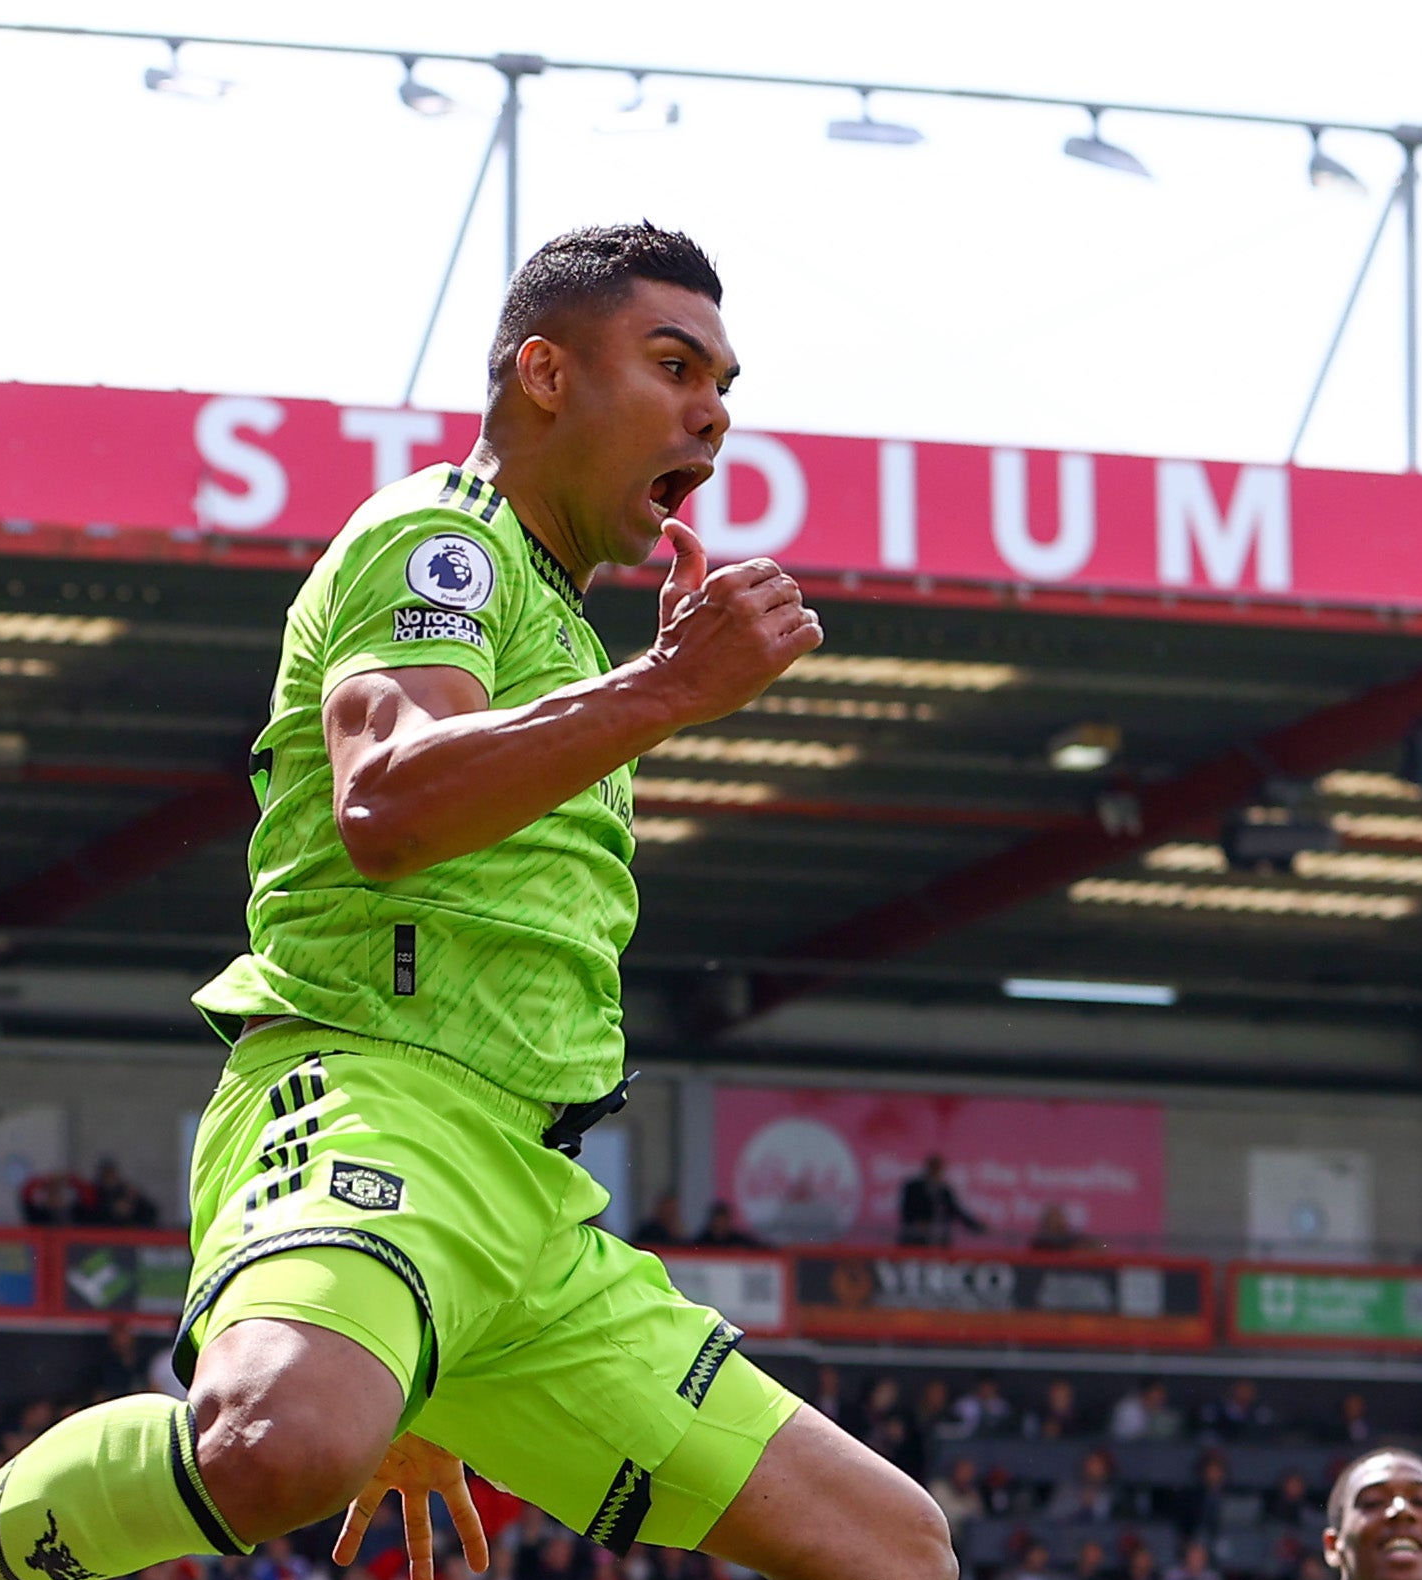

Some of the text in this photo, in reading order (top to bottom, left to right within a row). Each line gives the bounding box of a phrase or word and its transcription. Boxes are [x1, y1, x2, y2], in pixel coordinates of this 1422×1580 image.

[192, 396, 1295, 594] STDIUM
[424, 610, 478, 633] room
[422, 624, 485, 650] racism
